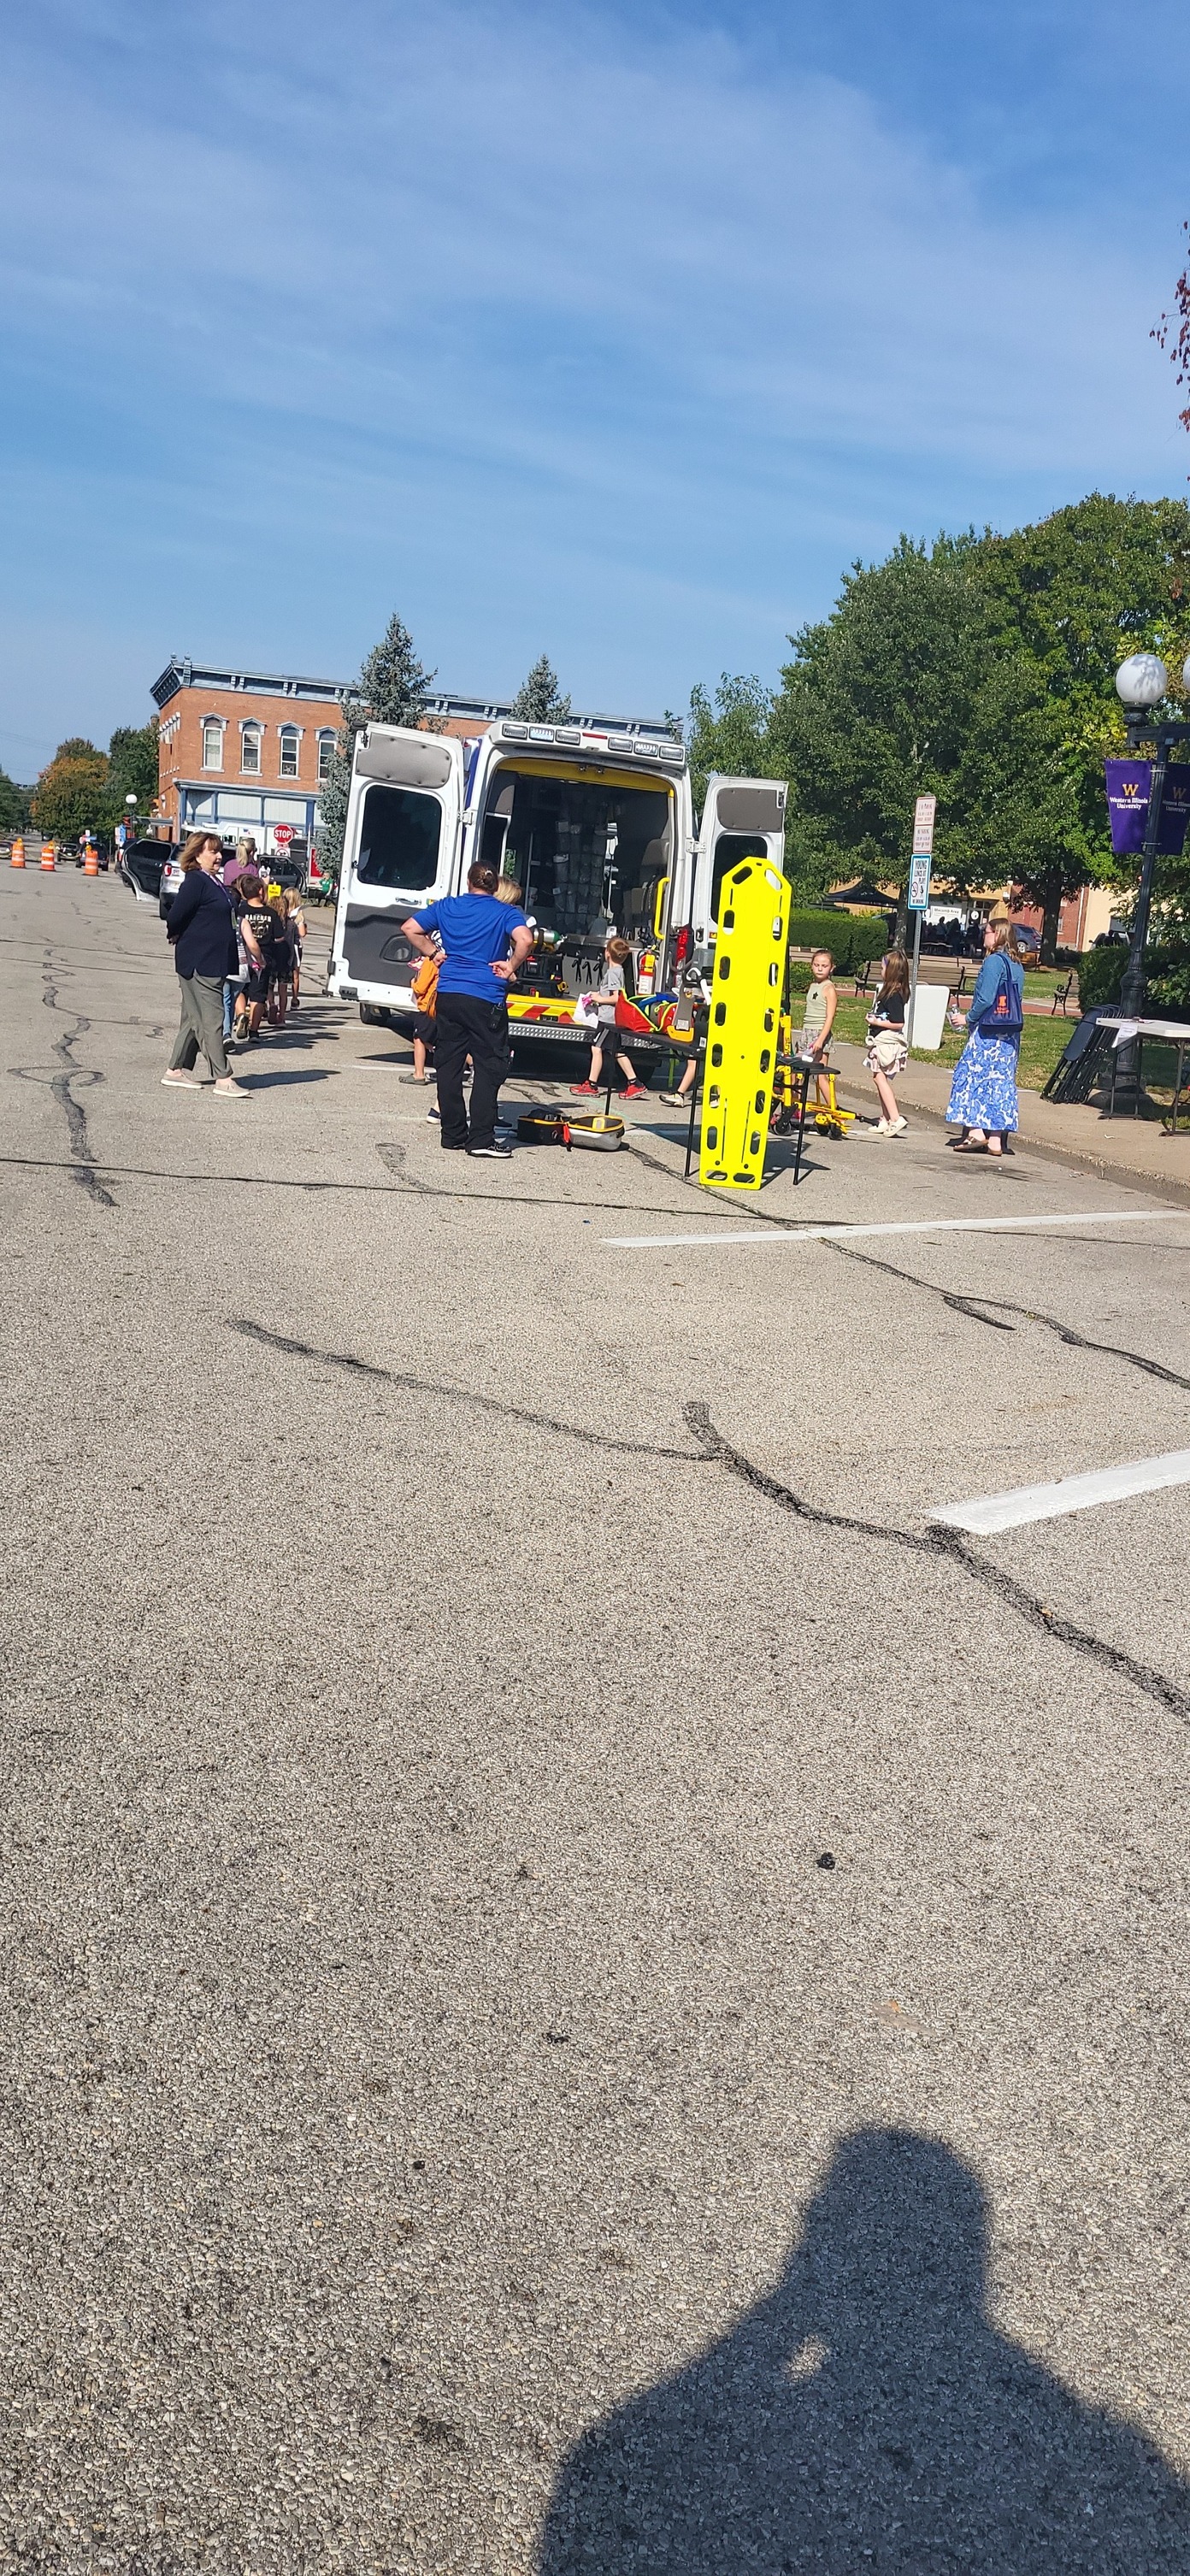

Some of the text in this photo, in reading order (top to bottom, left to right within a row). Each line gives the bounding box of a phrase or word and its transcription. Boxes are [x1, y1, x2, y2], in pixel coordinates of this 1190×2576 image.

[1122, 783, 1139, 796] W
[1173, 786, 1187, 799] W
[274, 829, 292, 838] STOP
[915, 860, 928, 869] YOUNG
